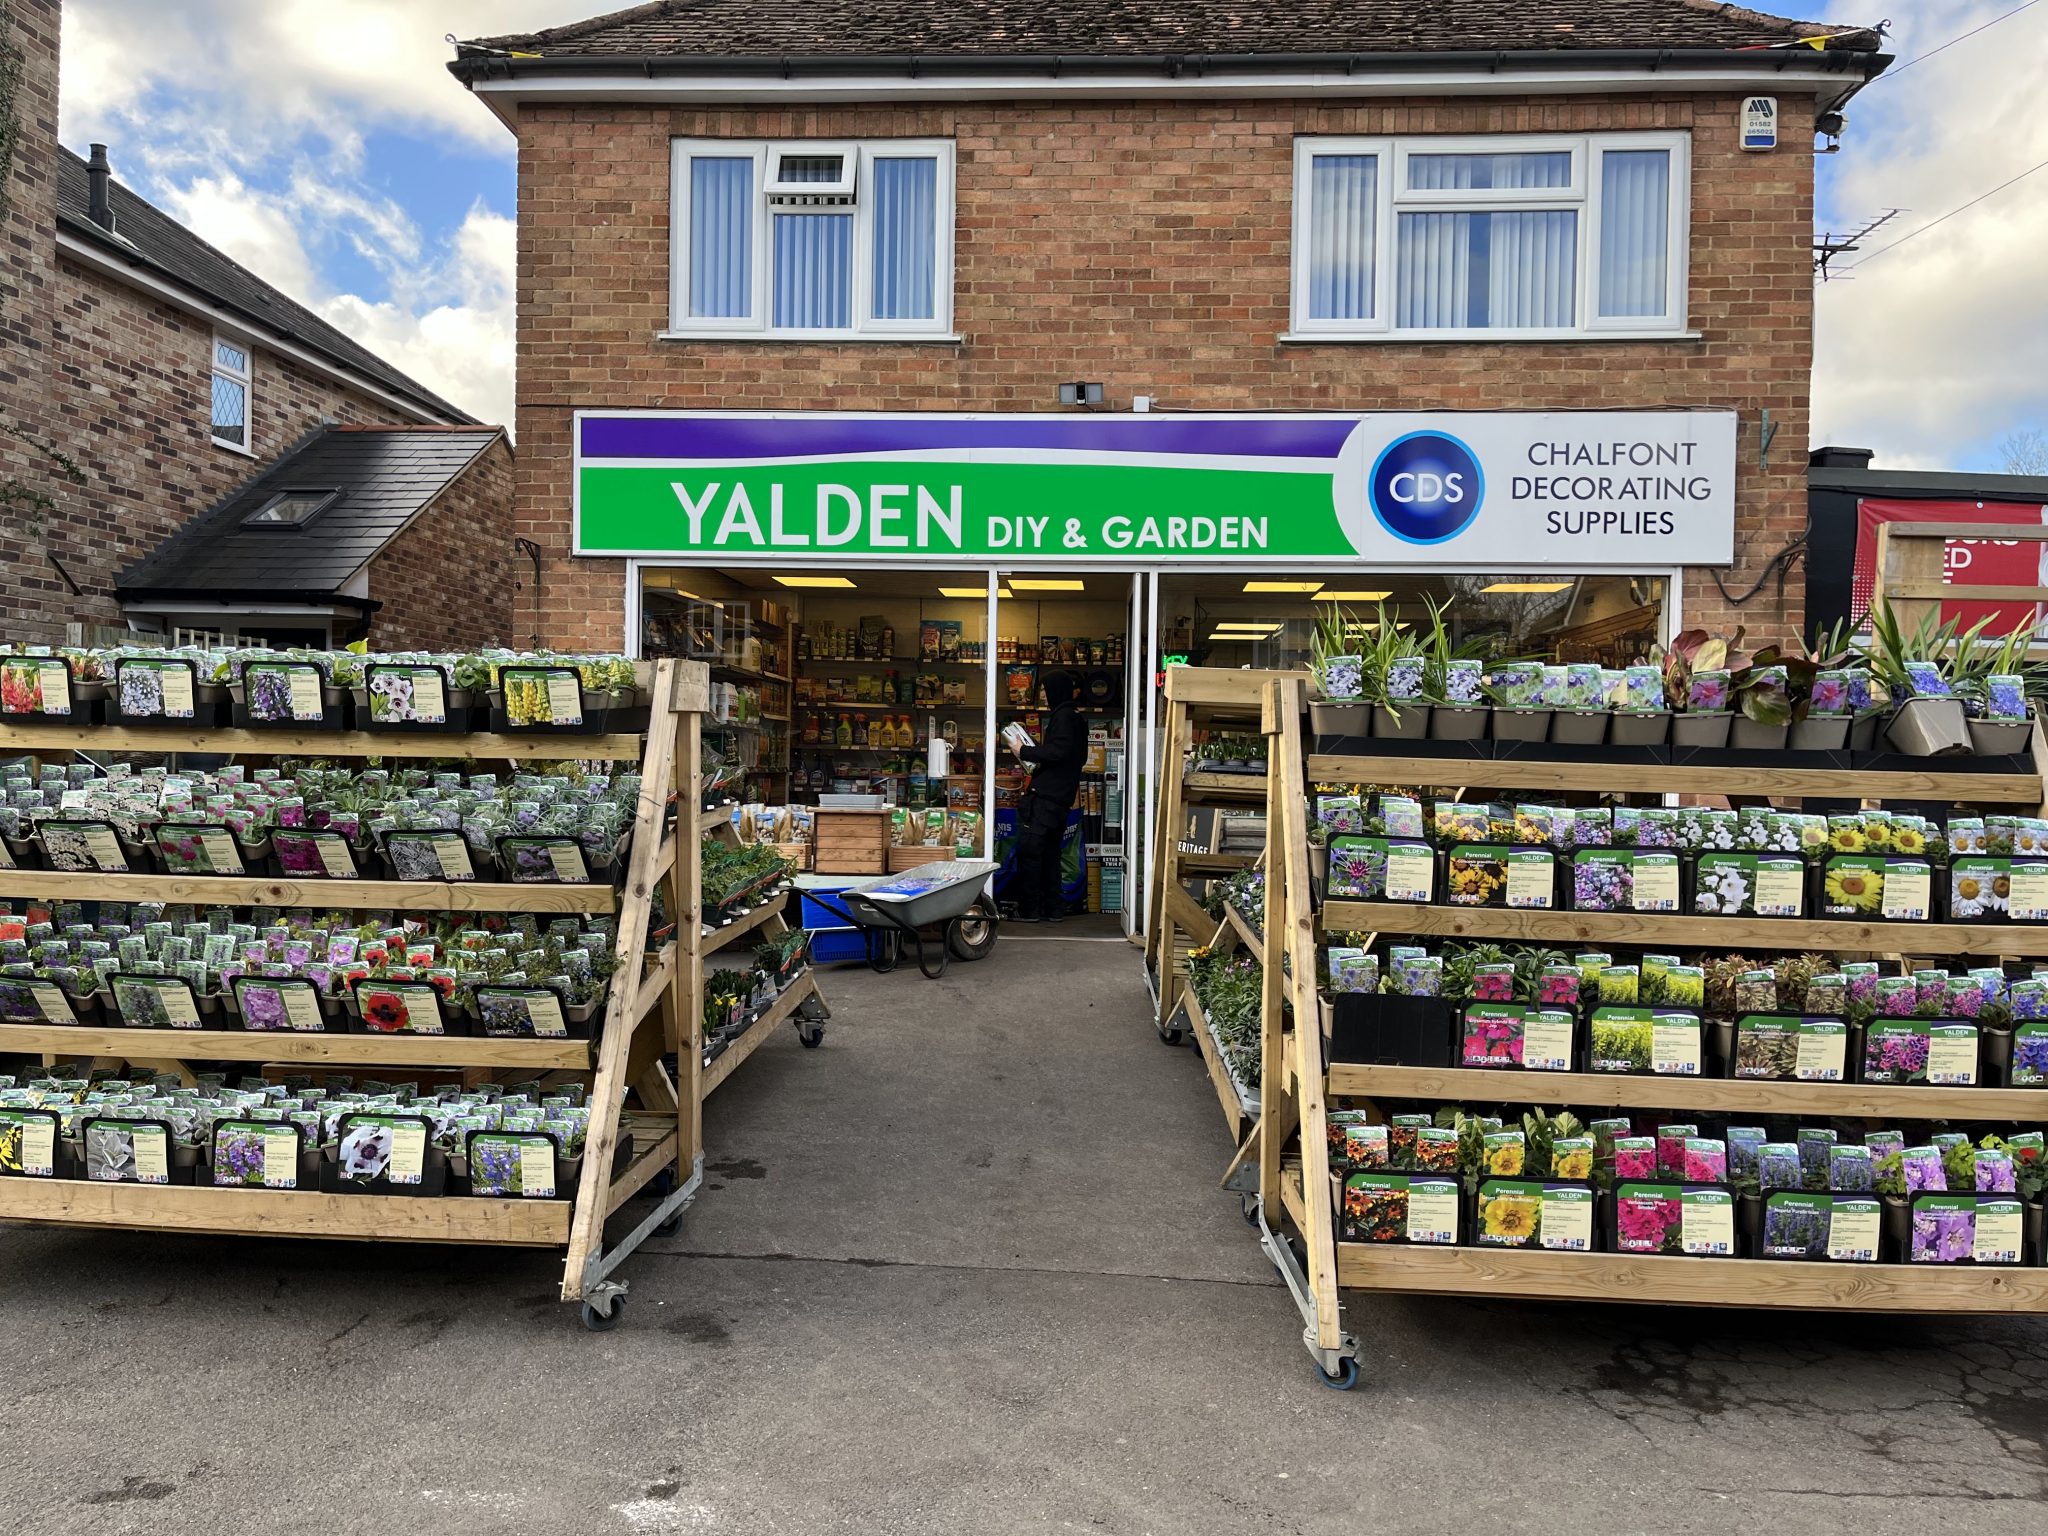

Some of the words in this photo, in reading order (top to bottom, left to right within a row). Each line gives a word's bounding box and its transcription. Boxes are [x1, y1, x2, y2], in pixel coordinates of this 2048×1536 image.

[1527, 442, 1697, 466] CHALFONT
[1389, 472, 1464, 504] CDS
[1512, 476, 1711, 501] DECORATING
[670, 482, 962, 548] YALDEN
[987, 516, 1049, 548] DIY
[1063, 517, 1087, 548] &
[1102, 516, 1268, 549] GARDEN
[1546, 510, 1674, 535] SUPPLIES
[1178, 841, 1208, 854] ERITAGE
[1401, 847, 1425, 855] YALDEN
